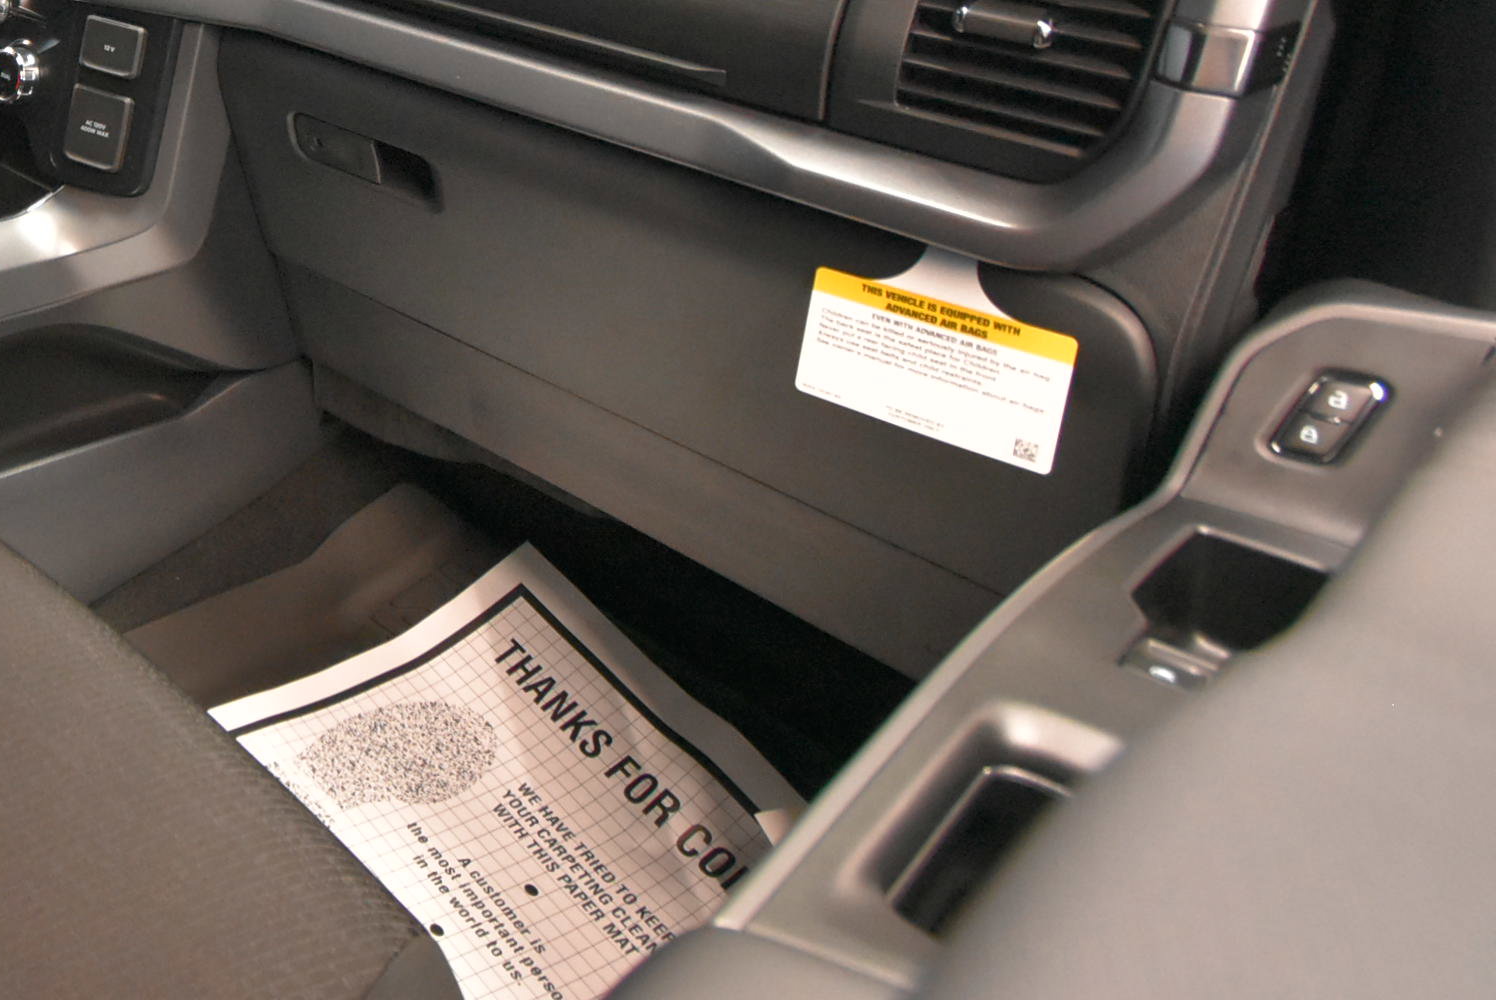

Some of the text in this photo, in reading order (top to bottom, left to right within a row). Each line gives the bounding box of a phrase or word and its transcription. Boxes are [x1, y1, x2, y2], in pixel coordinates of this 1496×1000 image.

[862, 283, 1021, 336] THIS VEHICLE IS EQUIPPED WITH
[872, 313, 998, 356] EVEN WITH ADVANCED AIR BAGS
[886, 302, 988, 339] ADVANCED AIR BAGS
[494, 637, 749, 890] THANKS FOR CO
[406, 821, 430, 845] the
[427, 846, 462, 880] most
[458, 882, 525, 955] important
[493, 803, 640, 955] WITH THIS PAPER MAT
[502, 789, 540, 828] YOUR
[537, 827, 614, 906] CARPETING
[518, 782, 542, 806] WE
[538, 804, 577, 843] HAVE
[573, 841, 616, 884] TRIED
[616, 883, 638, 905] TO
[412, 854, 524, 986] in the world to us.
[457, 856, 546, 955] A customer is
